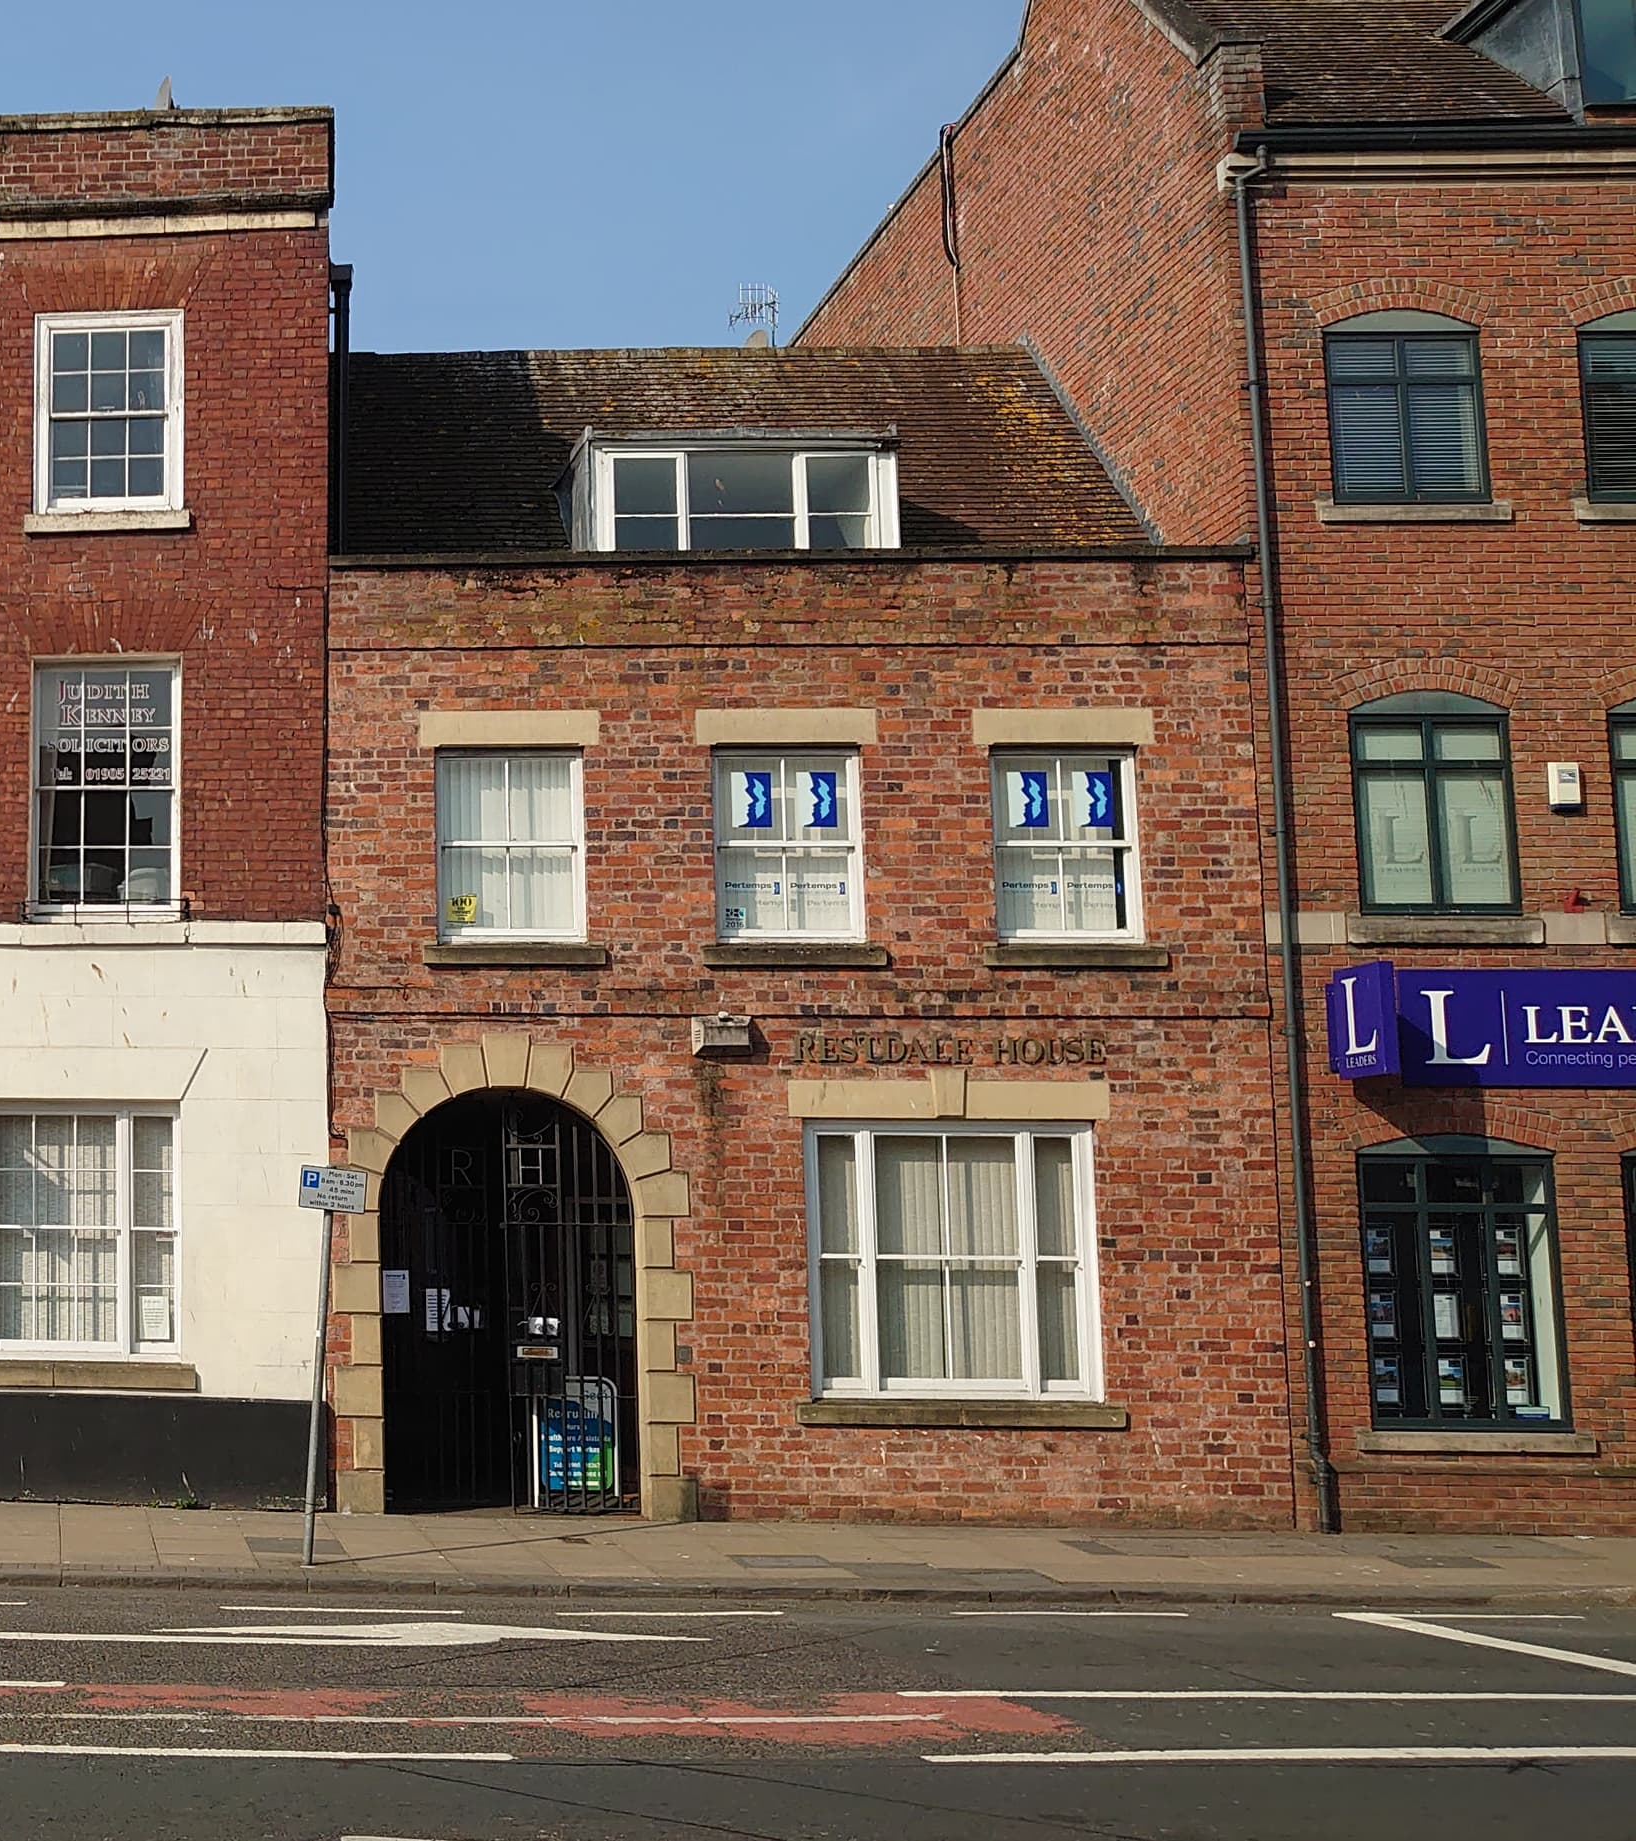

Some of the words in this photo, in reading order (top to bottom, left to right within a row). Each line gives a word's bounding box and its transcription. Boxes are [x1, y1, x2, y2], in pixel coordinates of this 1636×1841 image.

[57, 680, 150, 704] JUDITH
[60, 704, 156, 726] KENNEY
[48, 738, 170, 753] SOLICITORS
[725, 881, 772, 889] Pertemps
[790, 881, 837, 889] Pertemps
[1002, 881, 1049, 889] Pertemps
[1067, 881, 1113, 889] Pertemps
[1340, 977, 1377, 1055] L
[1420, 990, 1491, 1065] L
[1522, 1006, 1636, 1044] LEA
[794, 1033, 974, 1065] RESTDALE
[992, 1034, 1108, 1066] HOUSE
[1345, 1054, 1377, 1069] LEADERS
[1526, 1050, 1614, 1068] Connecting
[337, 1202, 354, 1210] hours
